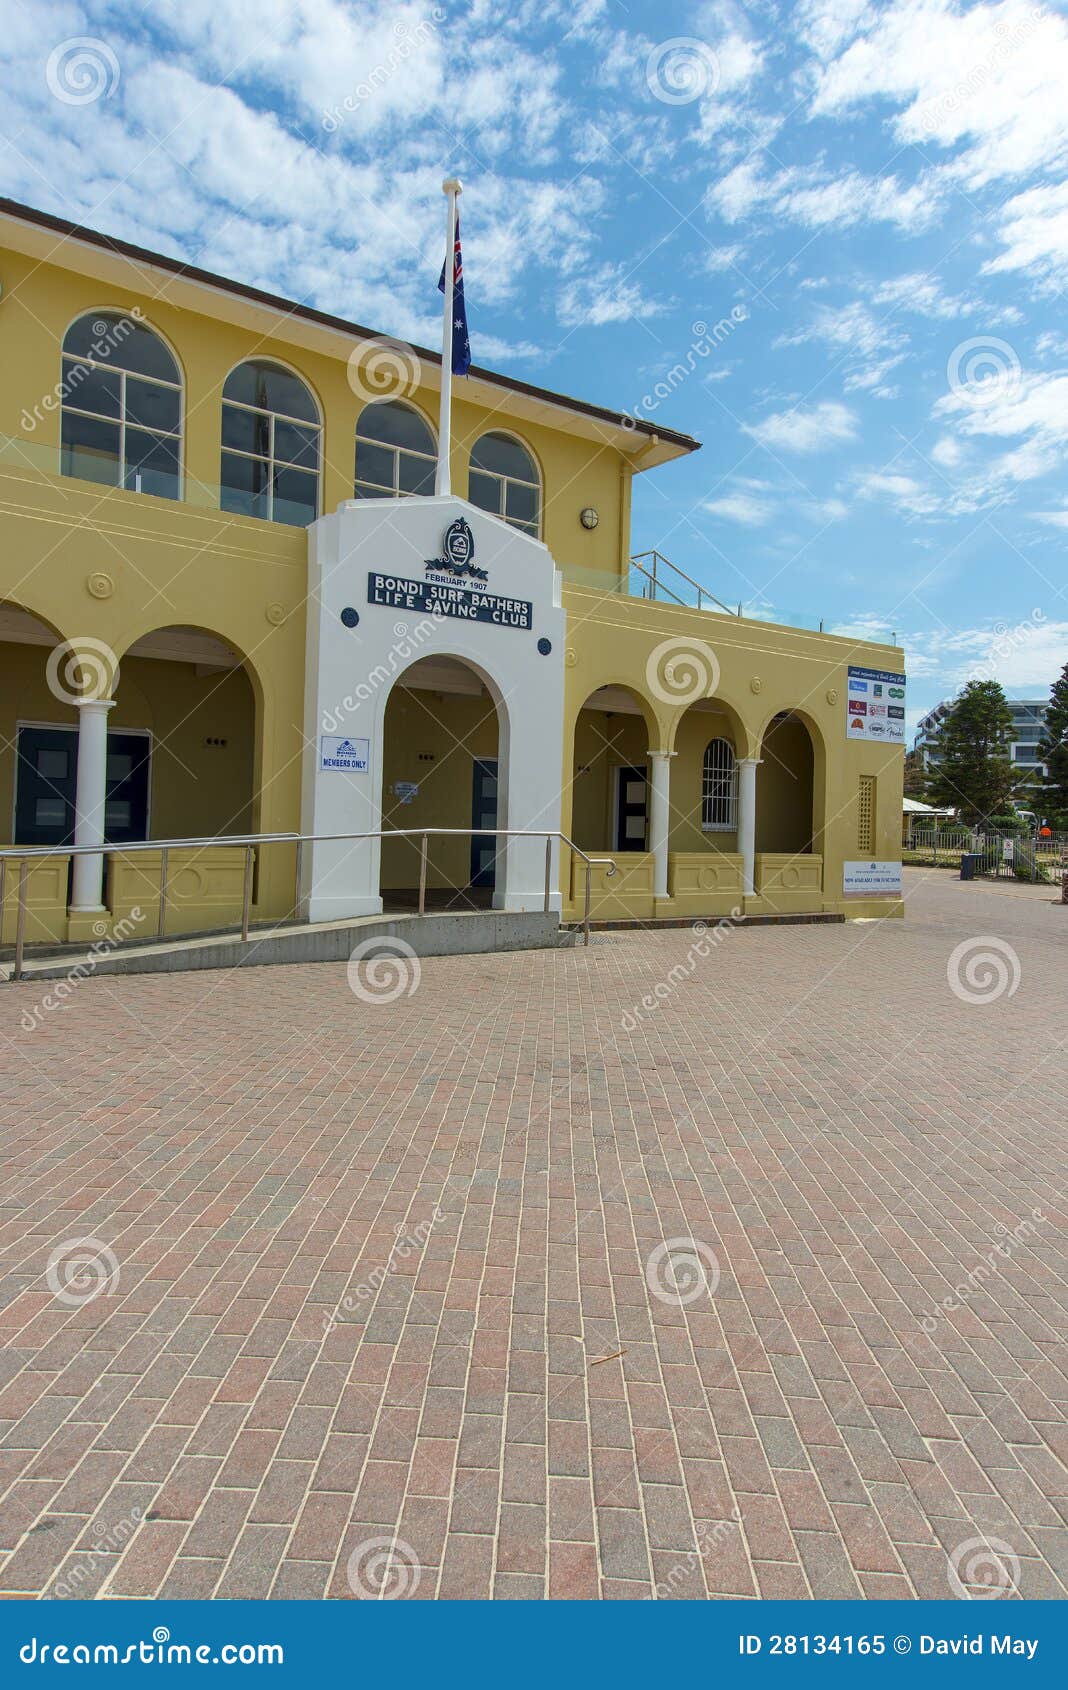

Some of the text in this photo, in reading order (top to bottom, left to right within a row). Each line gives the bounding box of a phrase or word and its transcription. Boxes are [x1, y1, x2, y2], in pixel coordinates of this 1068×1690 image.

[375, 575, 528, 615] BONDI SURF BATHERS
[425, 573, 488, 591] FEBRUARY 1907
[374, 589, 528, 627] LIFE SAVING CLUB
[323, 758, 367, 769] MEMBERS ONLY
